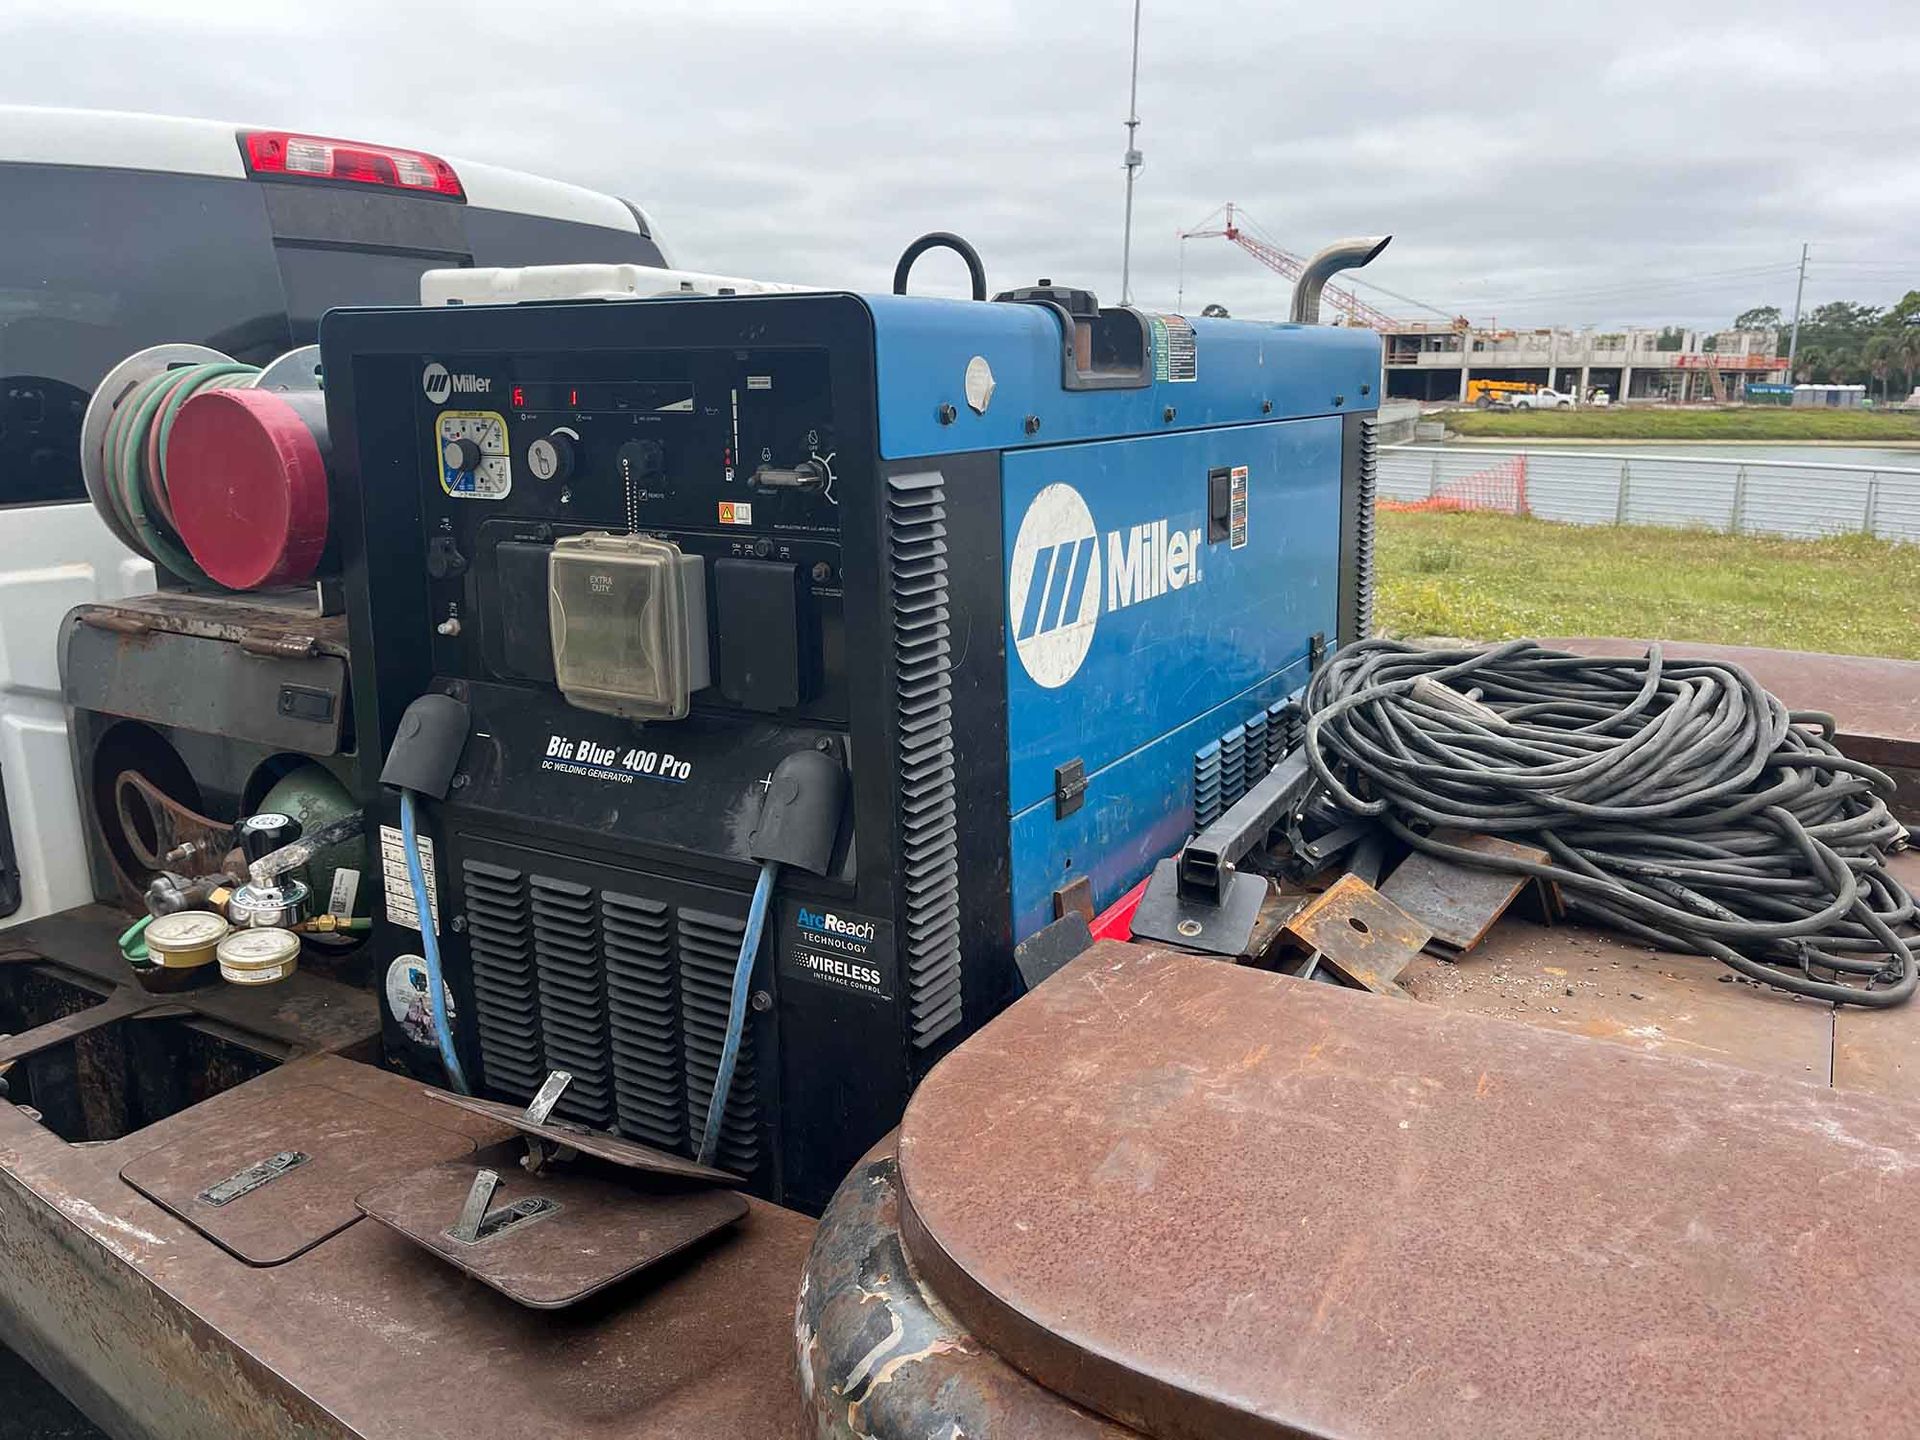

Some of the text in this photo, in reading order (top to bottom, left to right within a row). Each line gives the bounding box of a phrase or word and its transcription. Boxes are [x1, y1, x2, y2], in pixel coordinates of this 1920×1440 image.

[452, 374, 491, 393] Miller
[1107, 519, 1201, 612] Miller
[589, 575, 613, 585] EXTRA
[592, 584, 611, 593] DUTY
[575, 740, 615, 766] Blue
[622, 749, 657, 774] 400
[659, 753, 692, 780] Pro
[541, 760, 634, 784] DC WELDING GENERATOR
[797, 907, 875, 940] ArcReach
[803, 932, 867, 953] TECHNOLOGY
[802, 954, 881, 985] WIRELESS
[813, 972, 881, 995] INTERFACE CONTROL
